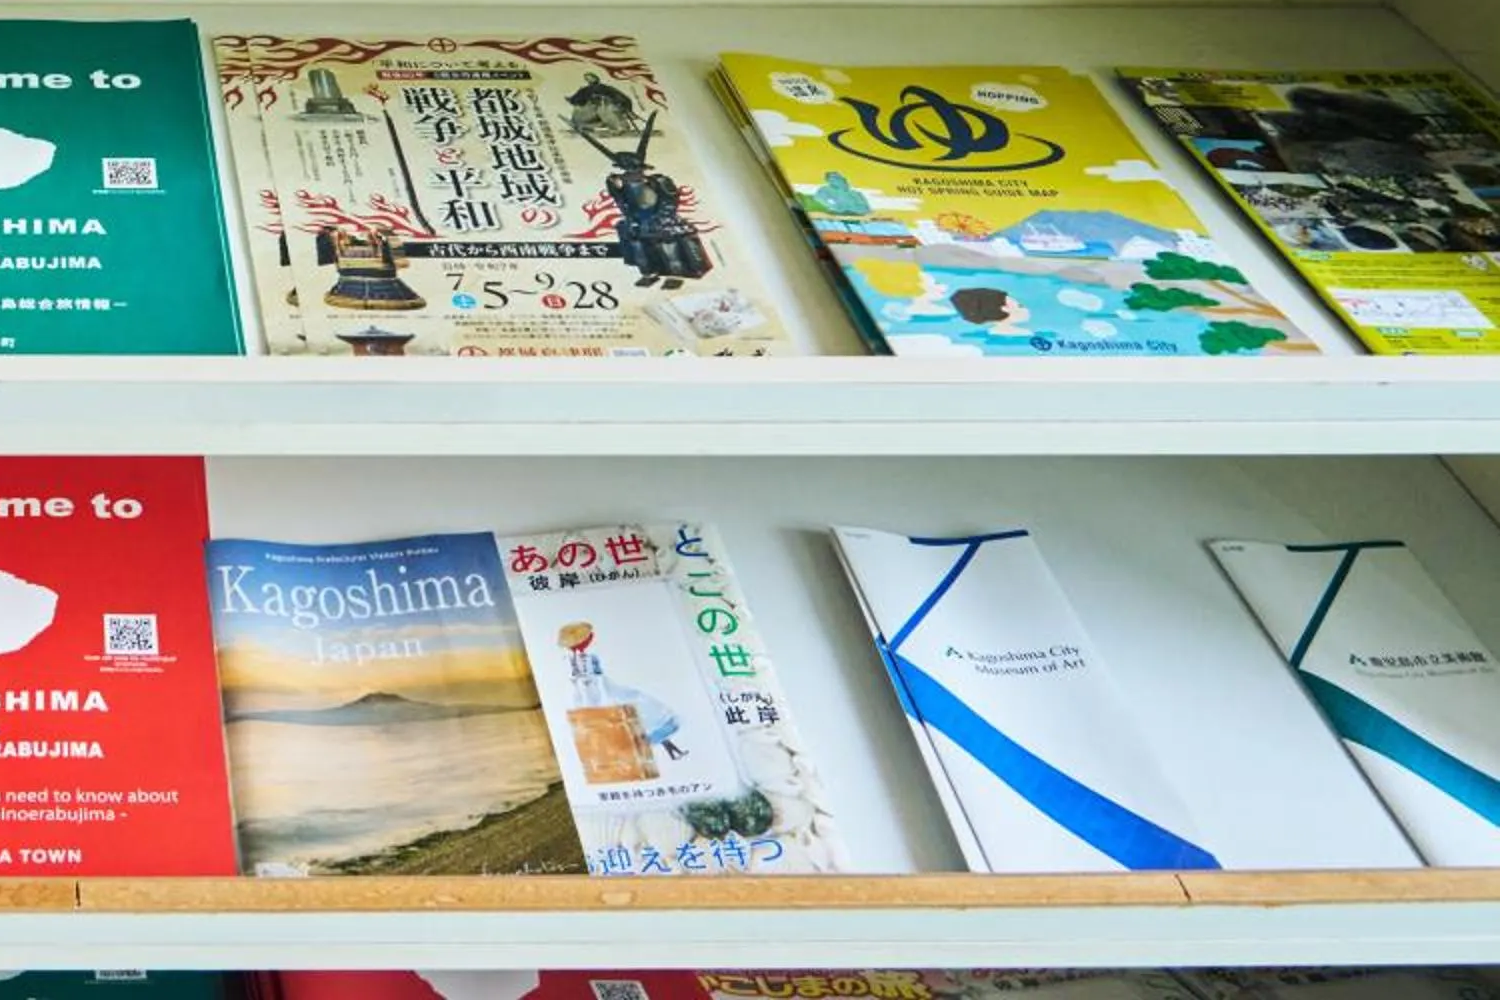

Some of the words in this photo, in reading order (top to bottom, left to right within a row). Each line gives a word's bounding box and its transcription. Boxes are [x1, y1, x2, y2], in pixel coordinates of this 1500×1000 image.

[91, 68, 142, 90] to
[897, 186, 924, 195] HOT
[927, 186, 979, 196] SPRING
[983, 187, 1024, 197] GUIDE
[1028, 189, 1059, 198] MAP
[912, 177, 994, 187] KAGOSHIMA
[997, 179, 1028, 188] CITY
[428, 244, 609, 258] 古代から西南戦争まで
[446, 273, 464, 291] 7
[483, 281, 509, 310] 5
[535, 272, 555, 290] 9
[566, 281, 619, 310] 28
[1058, 339, 1144, 354] Kagoshima
[1148, 339, 1178, 354] City
[91, 493, 143, 518] to
[510, 533, 649, 574] あの世
[528, 571, 581, 592] 彼岸
[217, 565, 496, 630] Kagoshima
[309, 635, 425, 667] Japan
[967, 650, 1046, 664] Kagoshima
[1049, 644, 1080, 657] City
[975, 663, 1039, 676] Museum
[1042, 661, 1058, 673] of
[1062, 657, 1086, 671] Art
[725, 705, 781, 727] 此岸
[5, 787, 49, 803] need
[53, 789, 71, 803] to
[75, 787, 124, 803] know
[127, 788, 179, 804] about
[19, 847, 83, 864] TOWN
[587, 836, 784, 876] 迎えを待つ
